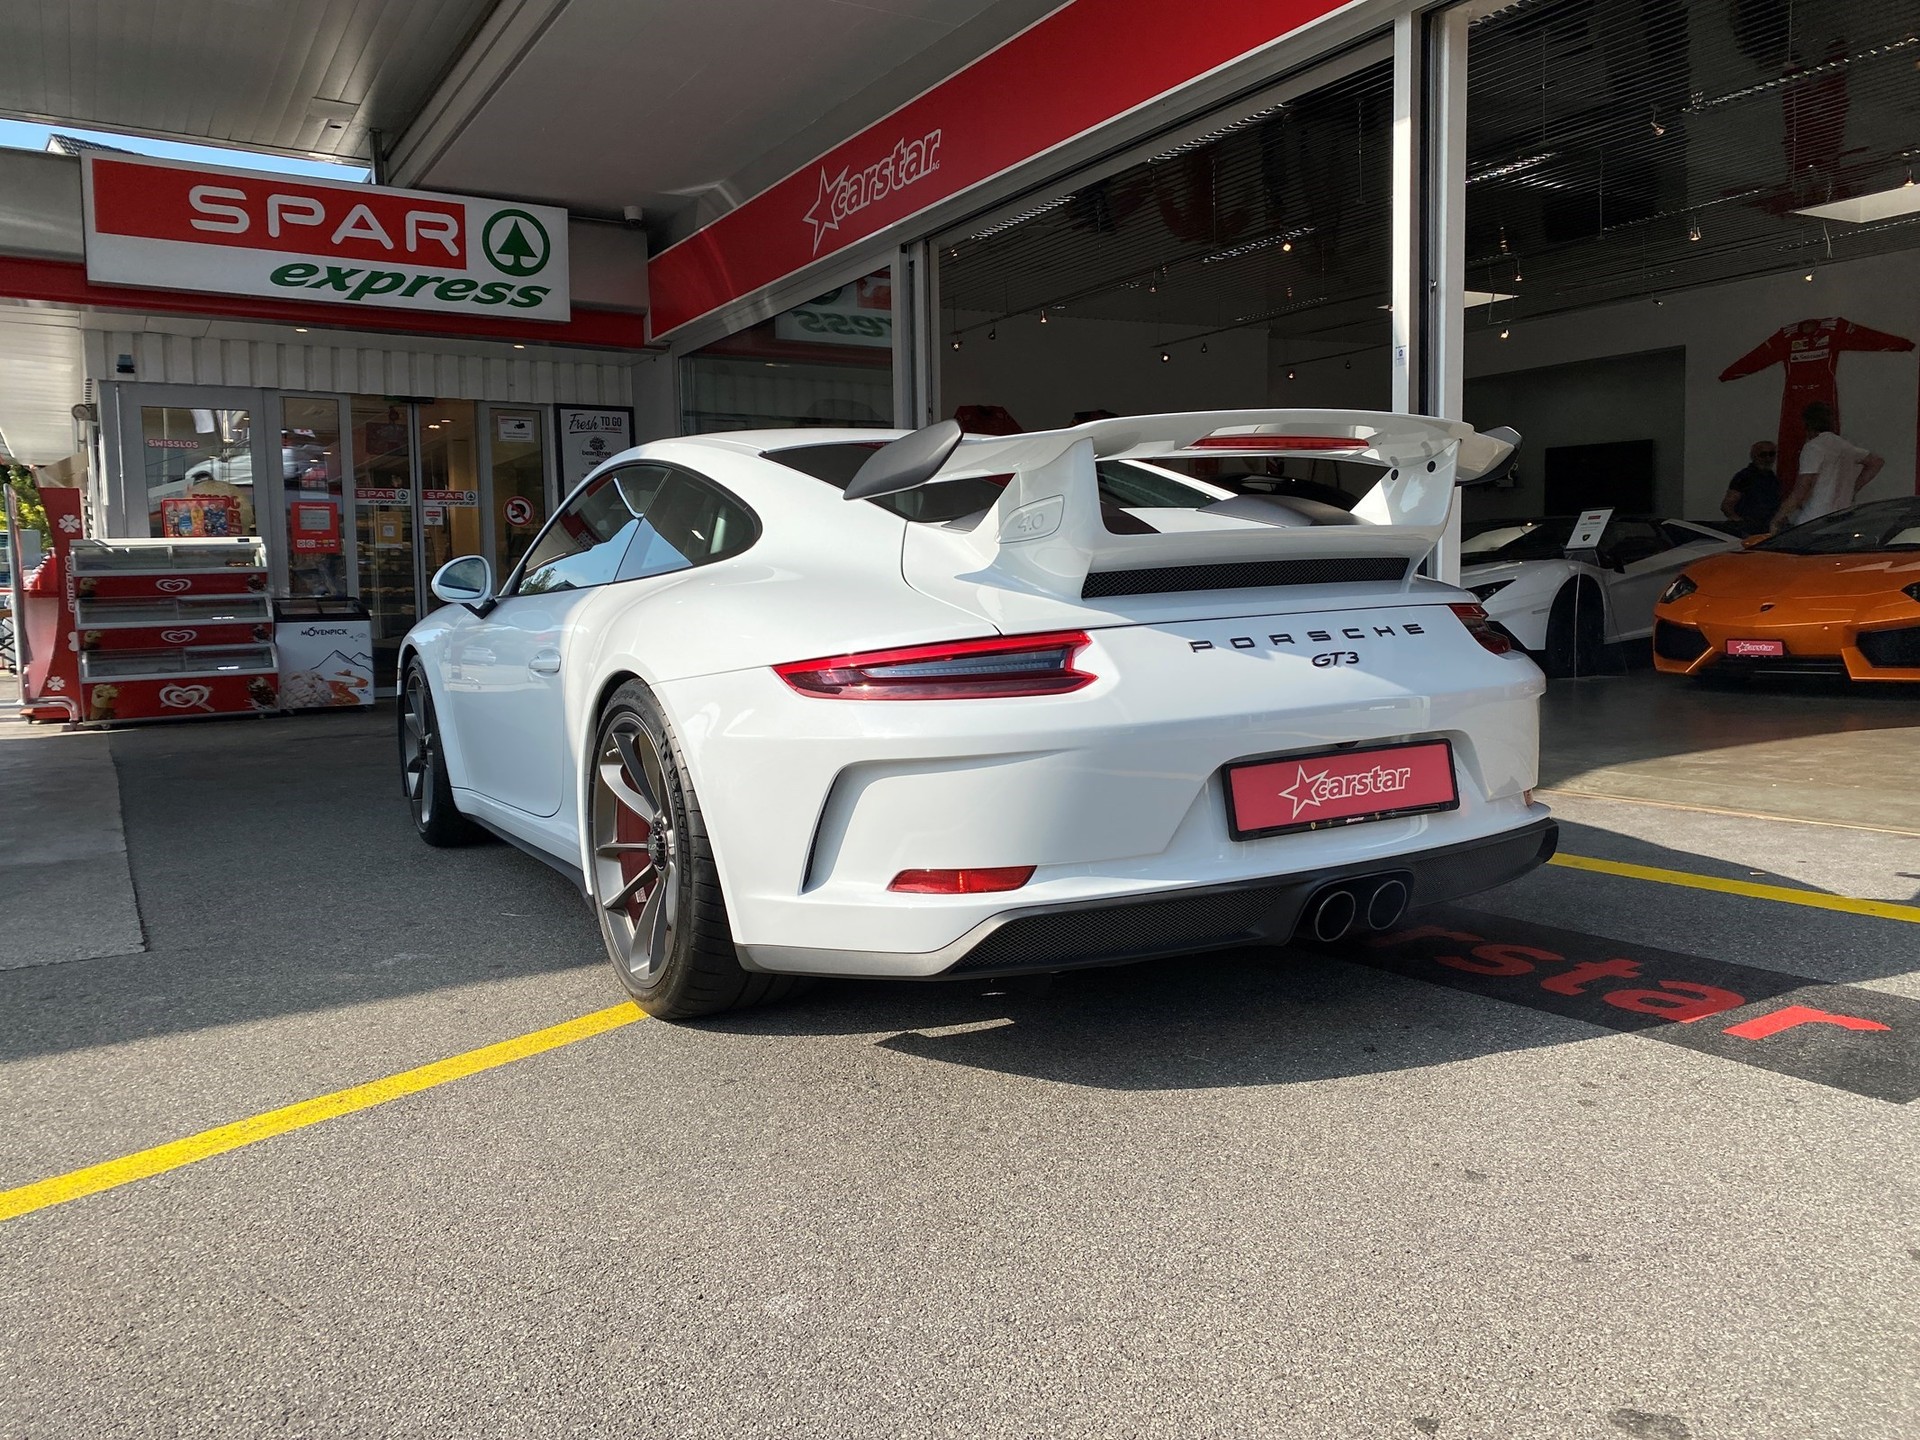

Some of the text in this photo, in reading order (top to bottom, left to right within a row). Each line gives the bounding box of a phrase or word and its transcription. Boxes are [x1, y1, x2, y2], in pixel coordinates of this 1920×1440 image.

[831, 128, 942, 221] carstar AG
[188, 184, 460, 257] SPAR
[269, 262, 552, 309] express
[568, 413, 622, 431] Fresh TO GO
[148, 439, 199, 449] SWISSLOS
[357, 490, 396, 498] SPAR
[426, 491, 464, 499] SPAR
[1187, 623, 1425, 653] PORSCHE
[1311, 651, 1360, 668] GT3
[1313, 765, 1411, 802] carstar
